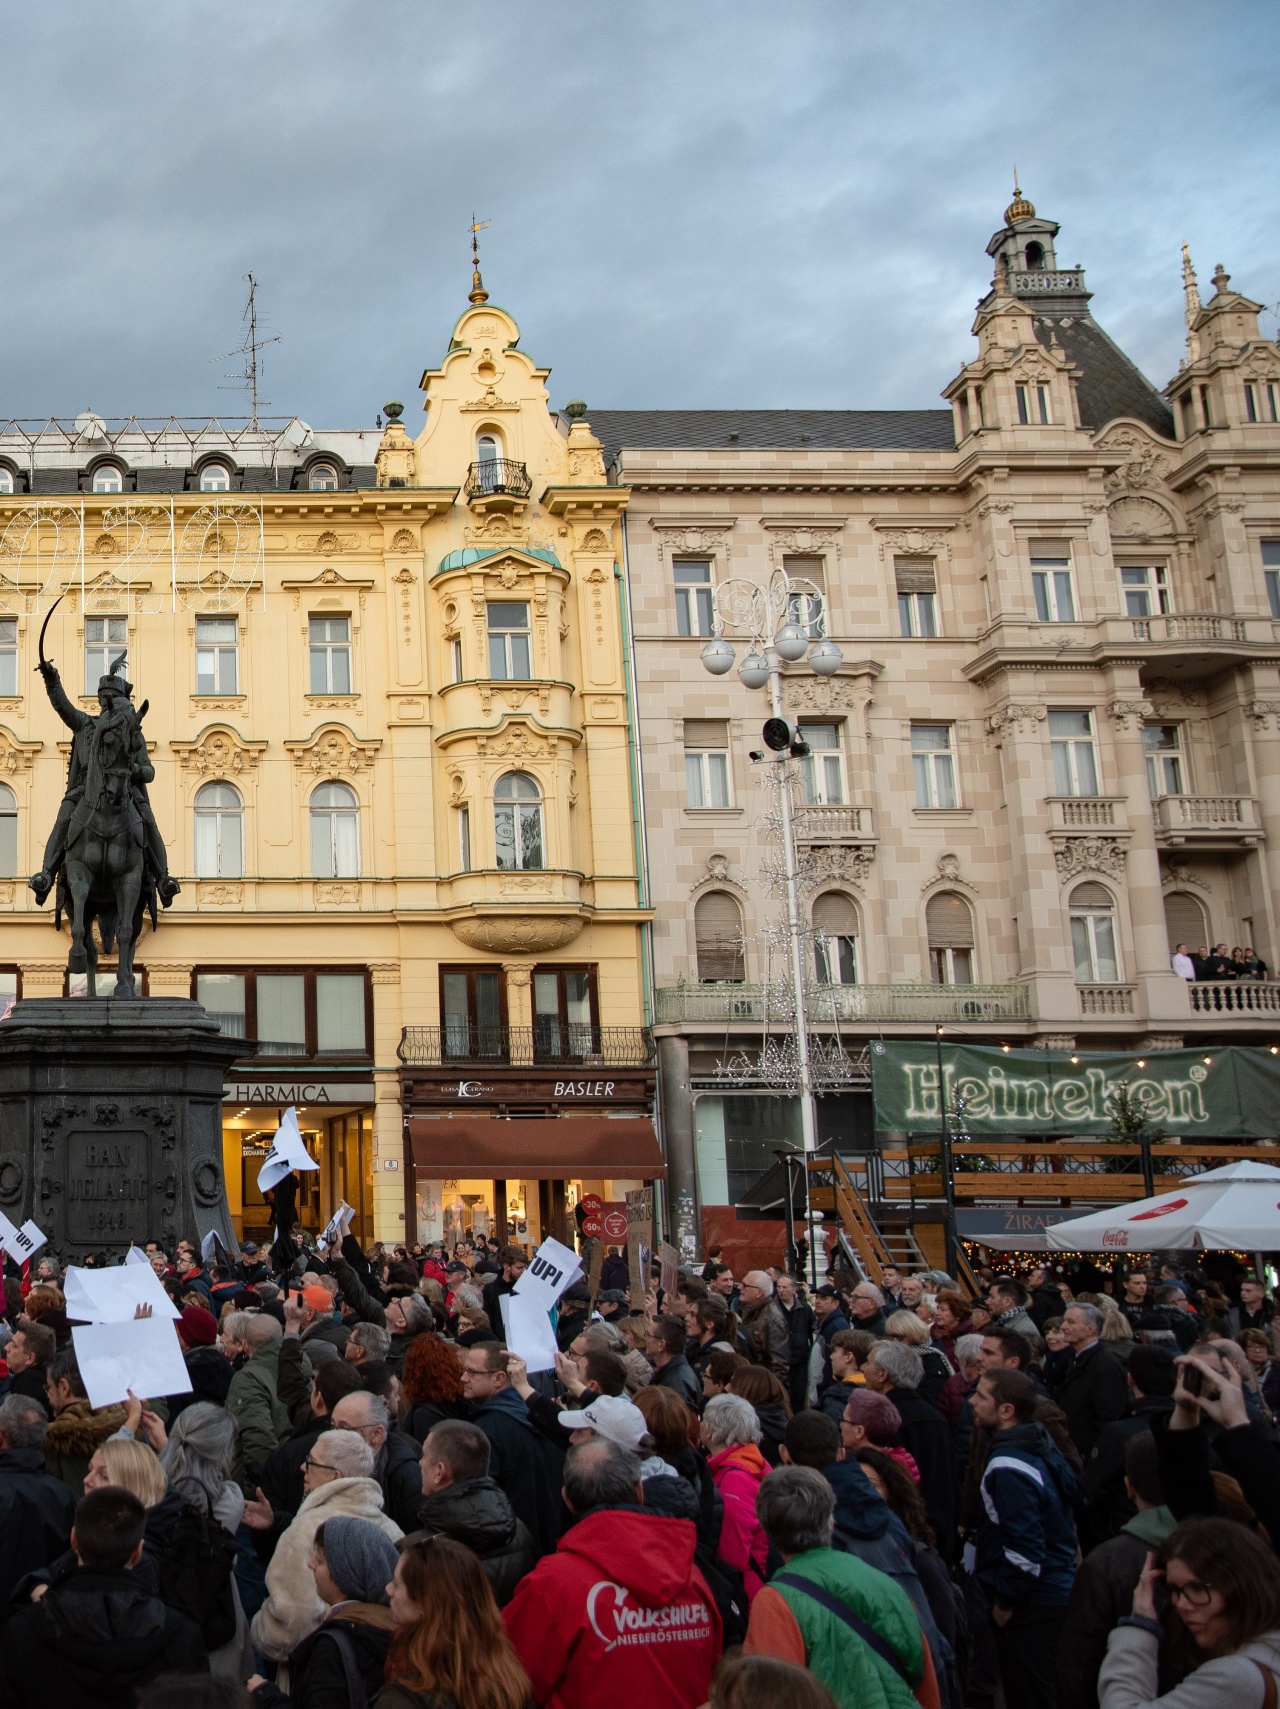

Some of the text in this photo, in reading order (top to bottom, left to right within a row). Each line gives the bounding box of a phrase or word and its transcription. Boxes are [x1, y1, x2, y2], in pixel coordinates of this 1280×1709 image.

[236, 1085, 330, 1102] HARMICA
[554, 1082, 615, 1096] BASLER
[903, 1064, 1209, 1123] Heineken
[86, 1146, 130, 1167] BAN
[16, 1231, 35, 1252] UPI
[531, 1256, 564, 1288] UPI
[612, 1603, 709, 1633] VOLKSHILFE
[617, 1626, 710, 1646] NIEDERÖSTERREICH
